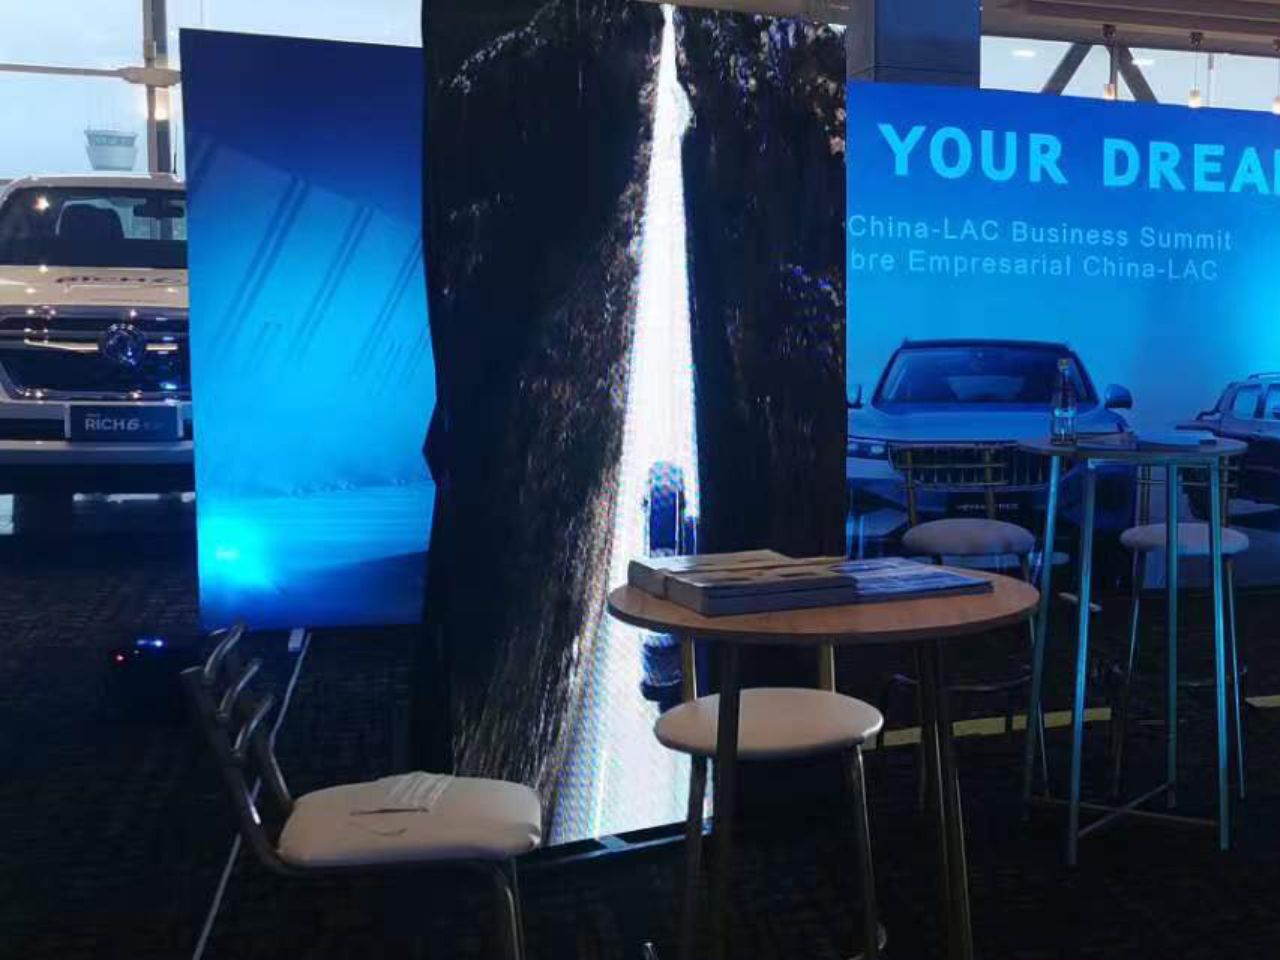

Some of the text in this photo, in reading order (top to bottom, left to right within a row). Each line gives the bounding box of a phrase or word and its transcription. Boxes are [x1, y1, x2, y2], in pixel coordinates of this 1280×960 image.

[877, 123, 1068, 184] YOUR
[848, 214, 1233, 252] China-LAC Business Summit
[908, 250, 1071, 277] Empresarial
[1082, 254, 1219, 281] China-LAC
